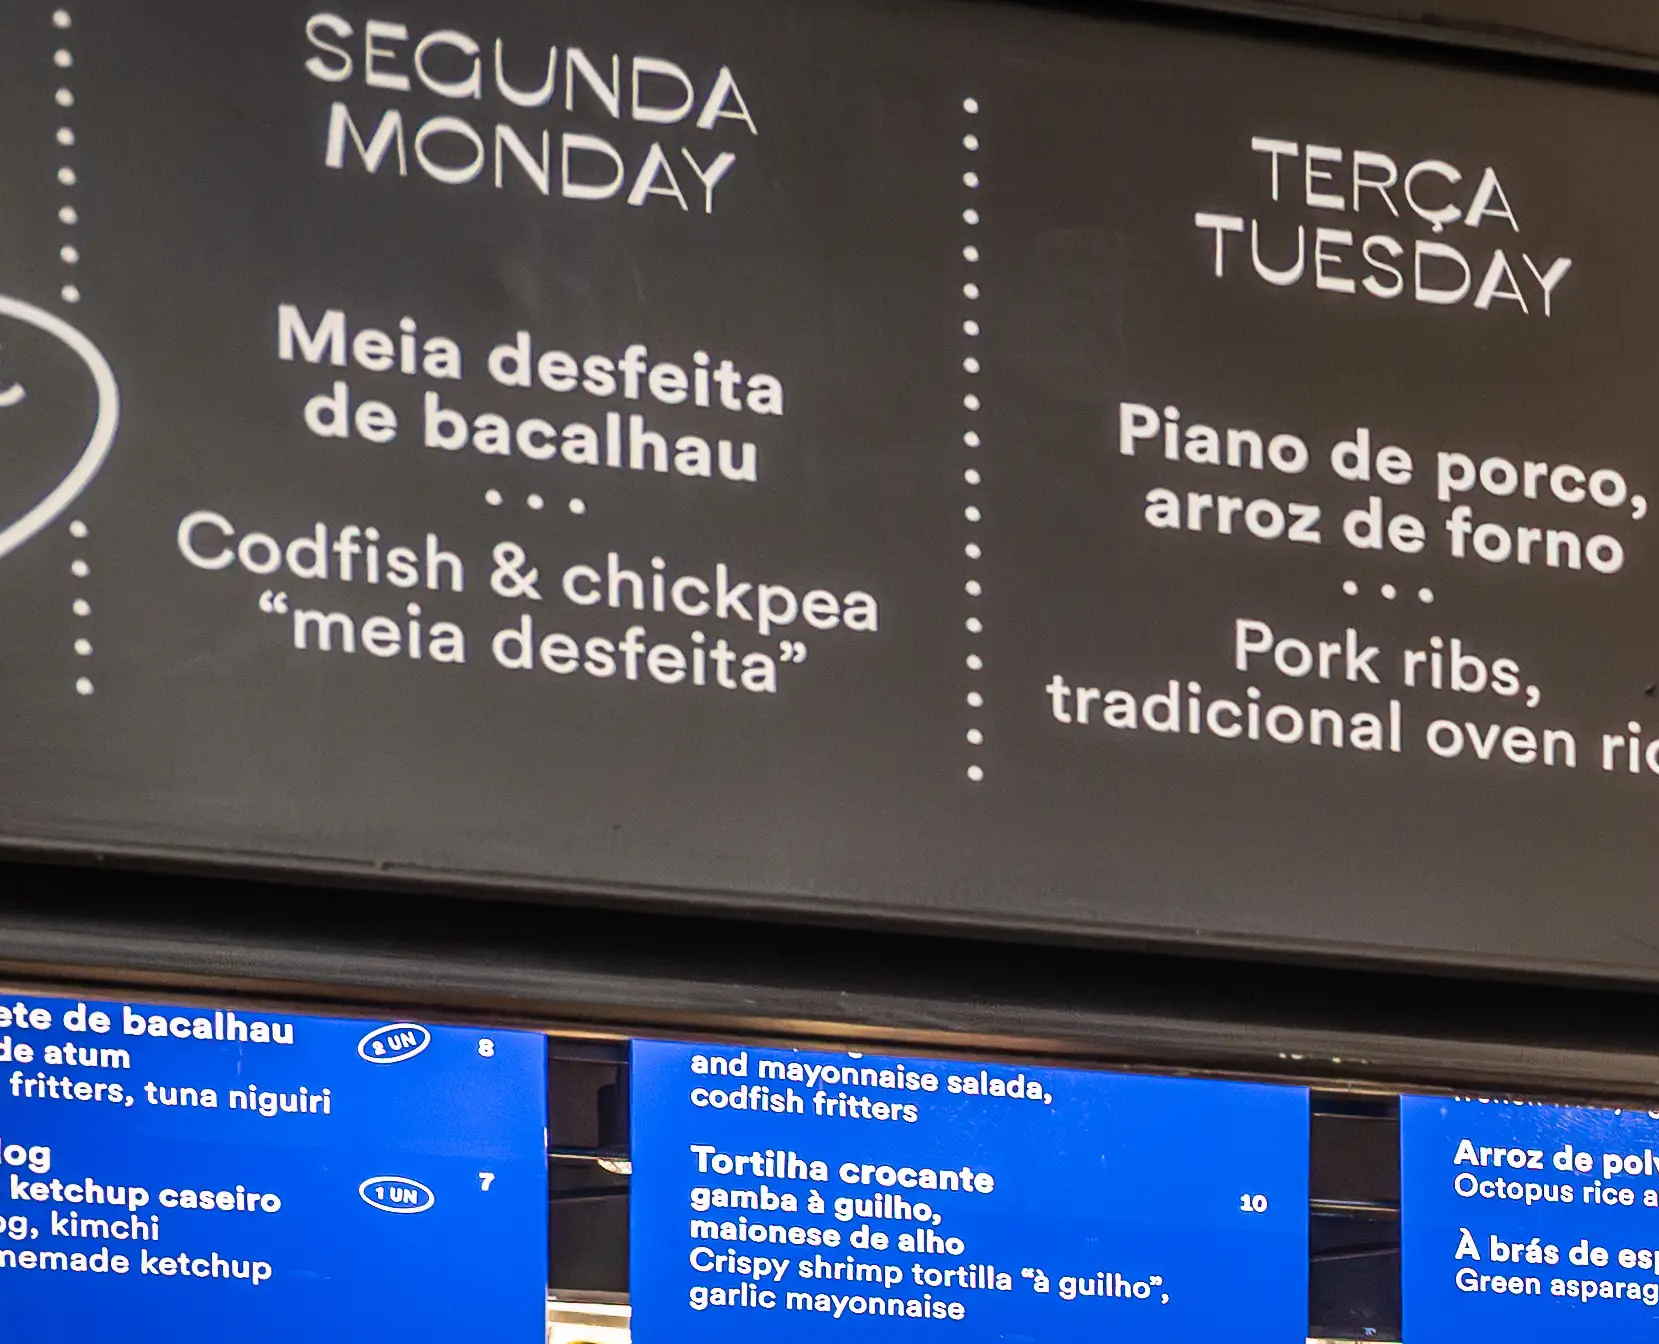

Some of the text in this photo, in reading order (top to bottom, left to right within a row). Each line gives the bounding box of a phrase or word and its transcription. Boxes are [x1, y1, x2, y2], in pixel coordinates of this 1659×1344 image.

[305, 13, 757, 134] SEGUNDA
[325, 102, 736, 213] MONDAY
[1252, 137, 1519, 233] TERÇA
[1195, 212, 1572, 316] TUESDAY
[278, 304, 783, 415] Meia desfeita
[304, 381, 756, 481] de bacalhau
[1120, 402, 1646, 519] Piano de porco,
[178, 511, 877, 635] Codfish & chickpea
[1145, 488, 1623, 573] arroz de forno
[259, 590, 806, 693] “meia desfeita”
[1236, 619, 1540, 707] Pork ribs,
[1046, 675, 1400, 752] tradicional
[1427, 720, 1576, 767] oven
[478, 1039, 494, 1057] 8
[9, 1071, 330, 1117] fritters, tuna niguiri
[691, 1085, 918, 1122] codfish fritters
[11, 1174, 281, 1212] ketchup caseiro
[479, 1172, 495, 1191] 7
[690, 1145, 994, 1193] Tortilha crocante
[1241, 1194, 1267, 1212] 10
[1455, 1173, 1573, 1205] Octopus
[1584, 1180, 1634, 1205] rice
[691, 1220, 964, 1255] maionese de alho
[690, 1282, 965, 1320] garlic mayonnaise
